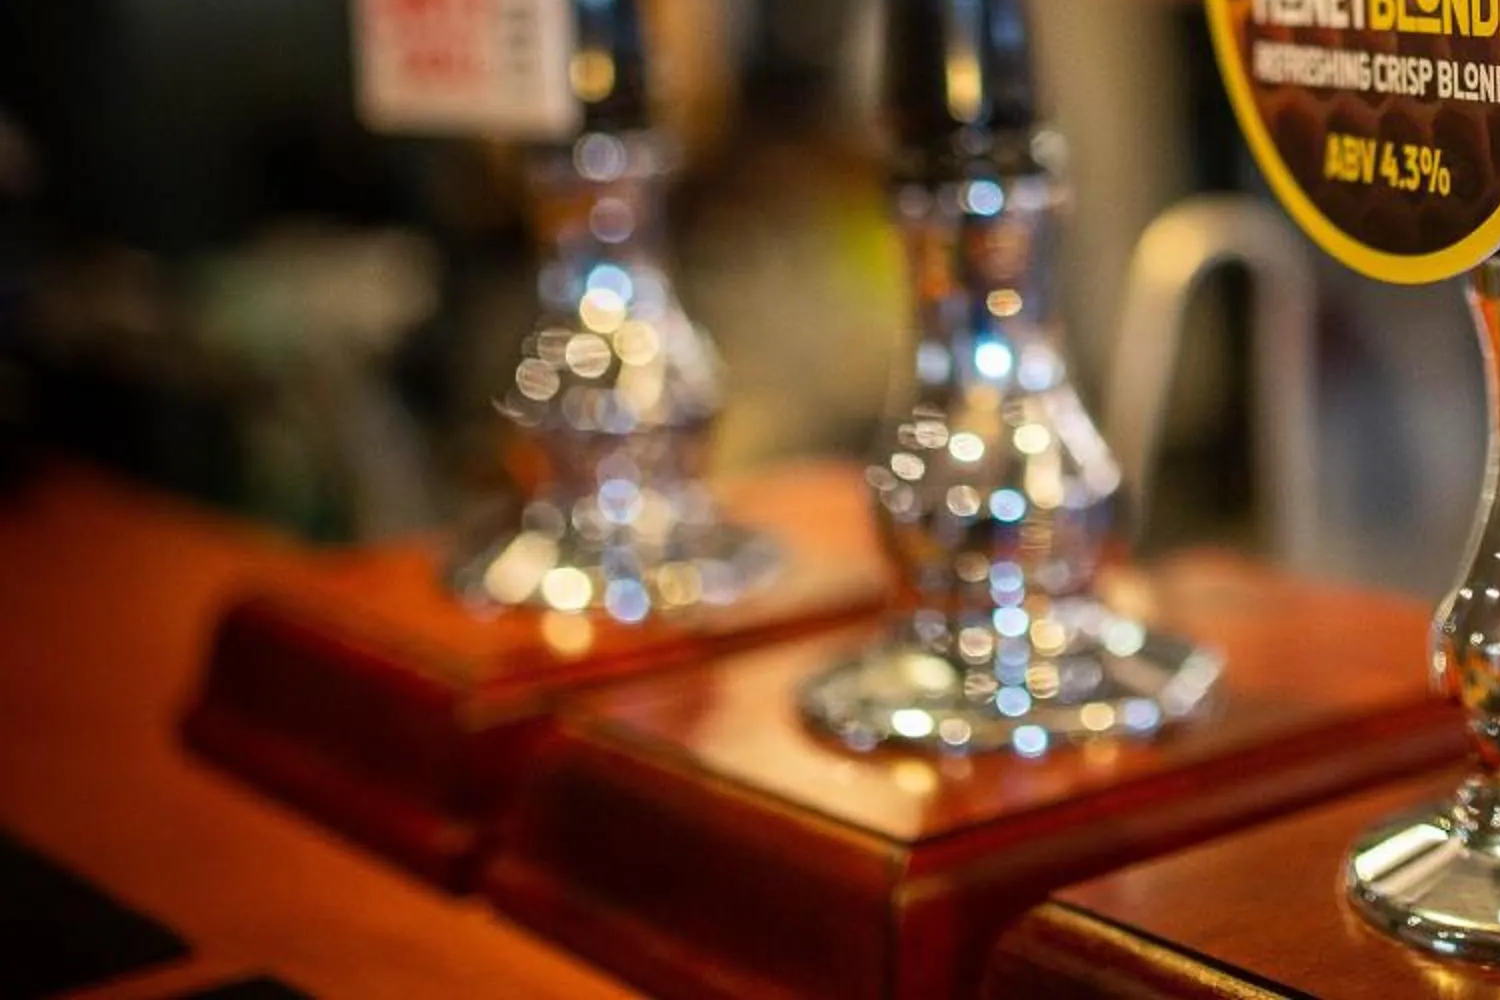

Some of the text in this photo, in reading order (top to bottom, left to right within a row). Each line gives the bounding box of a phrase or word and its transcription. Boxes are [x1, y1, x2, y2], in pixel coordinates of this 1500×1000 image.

[1373, 53, 1433, 98] CRISP
[1323, 131, 1452, 197] ABV 4.3%
